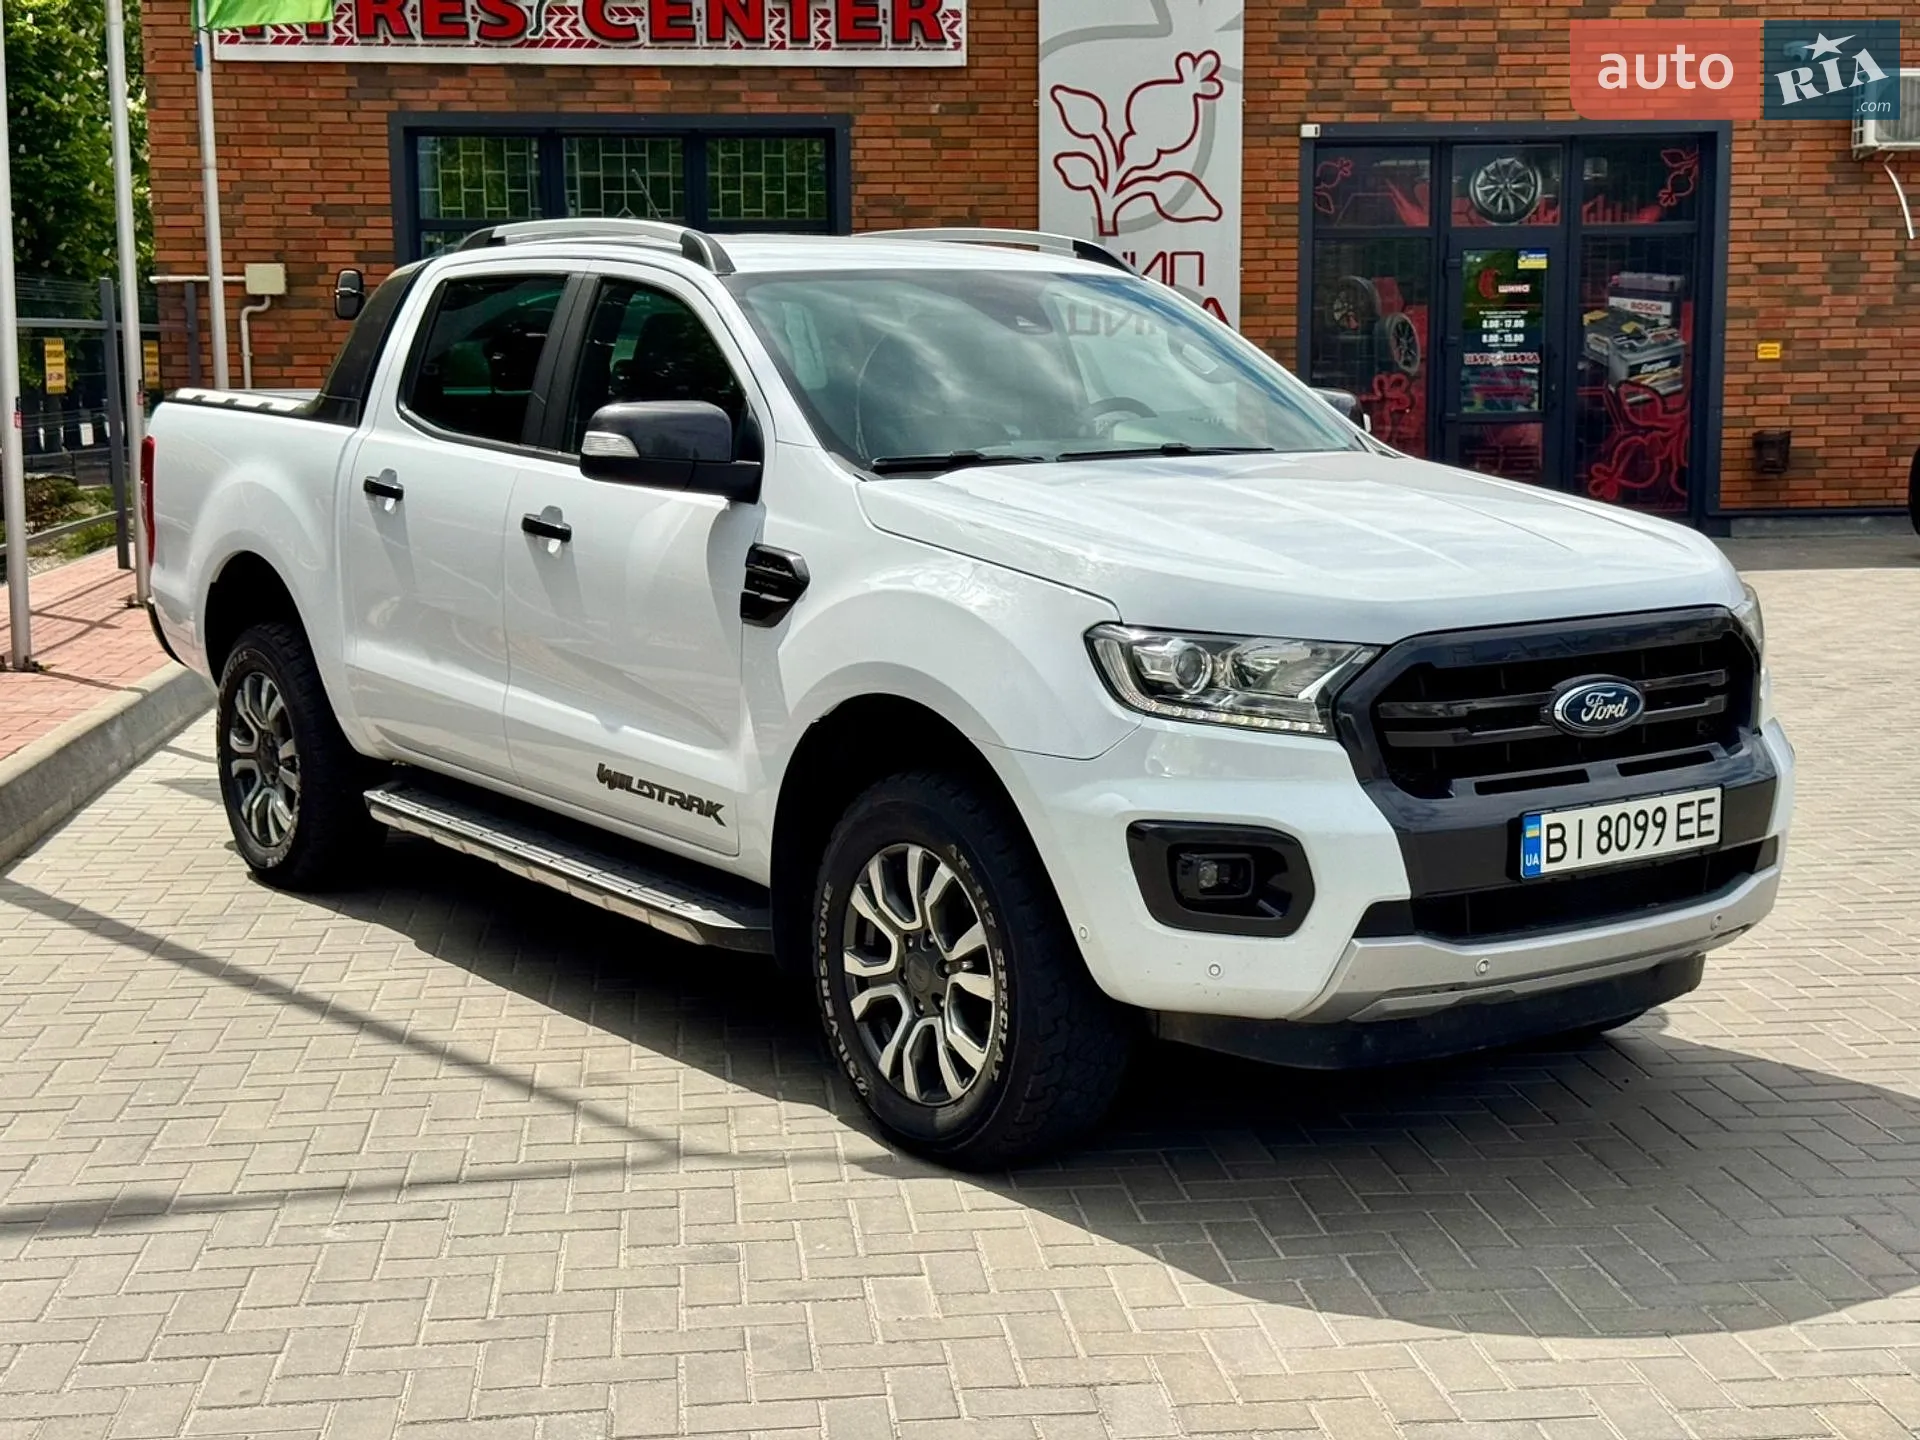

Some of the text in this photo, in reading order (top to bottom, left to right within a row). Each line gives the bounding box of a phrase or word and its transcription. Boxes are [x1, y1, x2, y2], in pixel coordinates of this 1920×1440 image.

[1581, 691, 1628, 722] Ford
[596, 762, 727, 828] WILDTRAK
[1546, 797, 1716, 865] BI 8099 EE
[1525, 851, 1540, 867] UA
